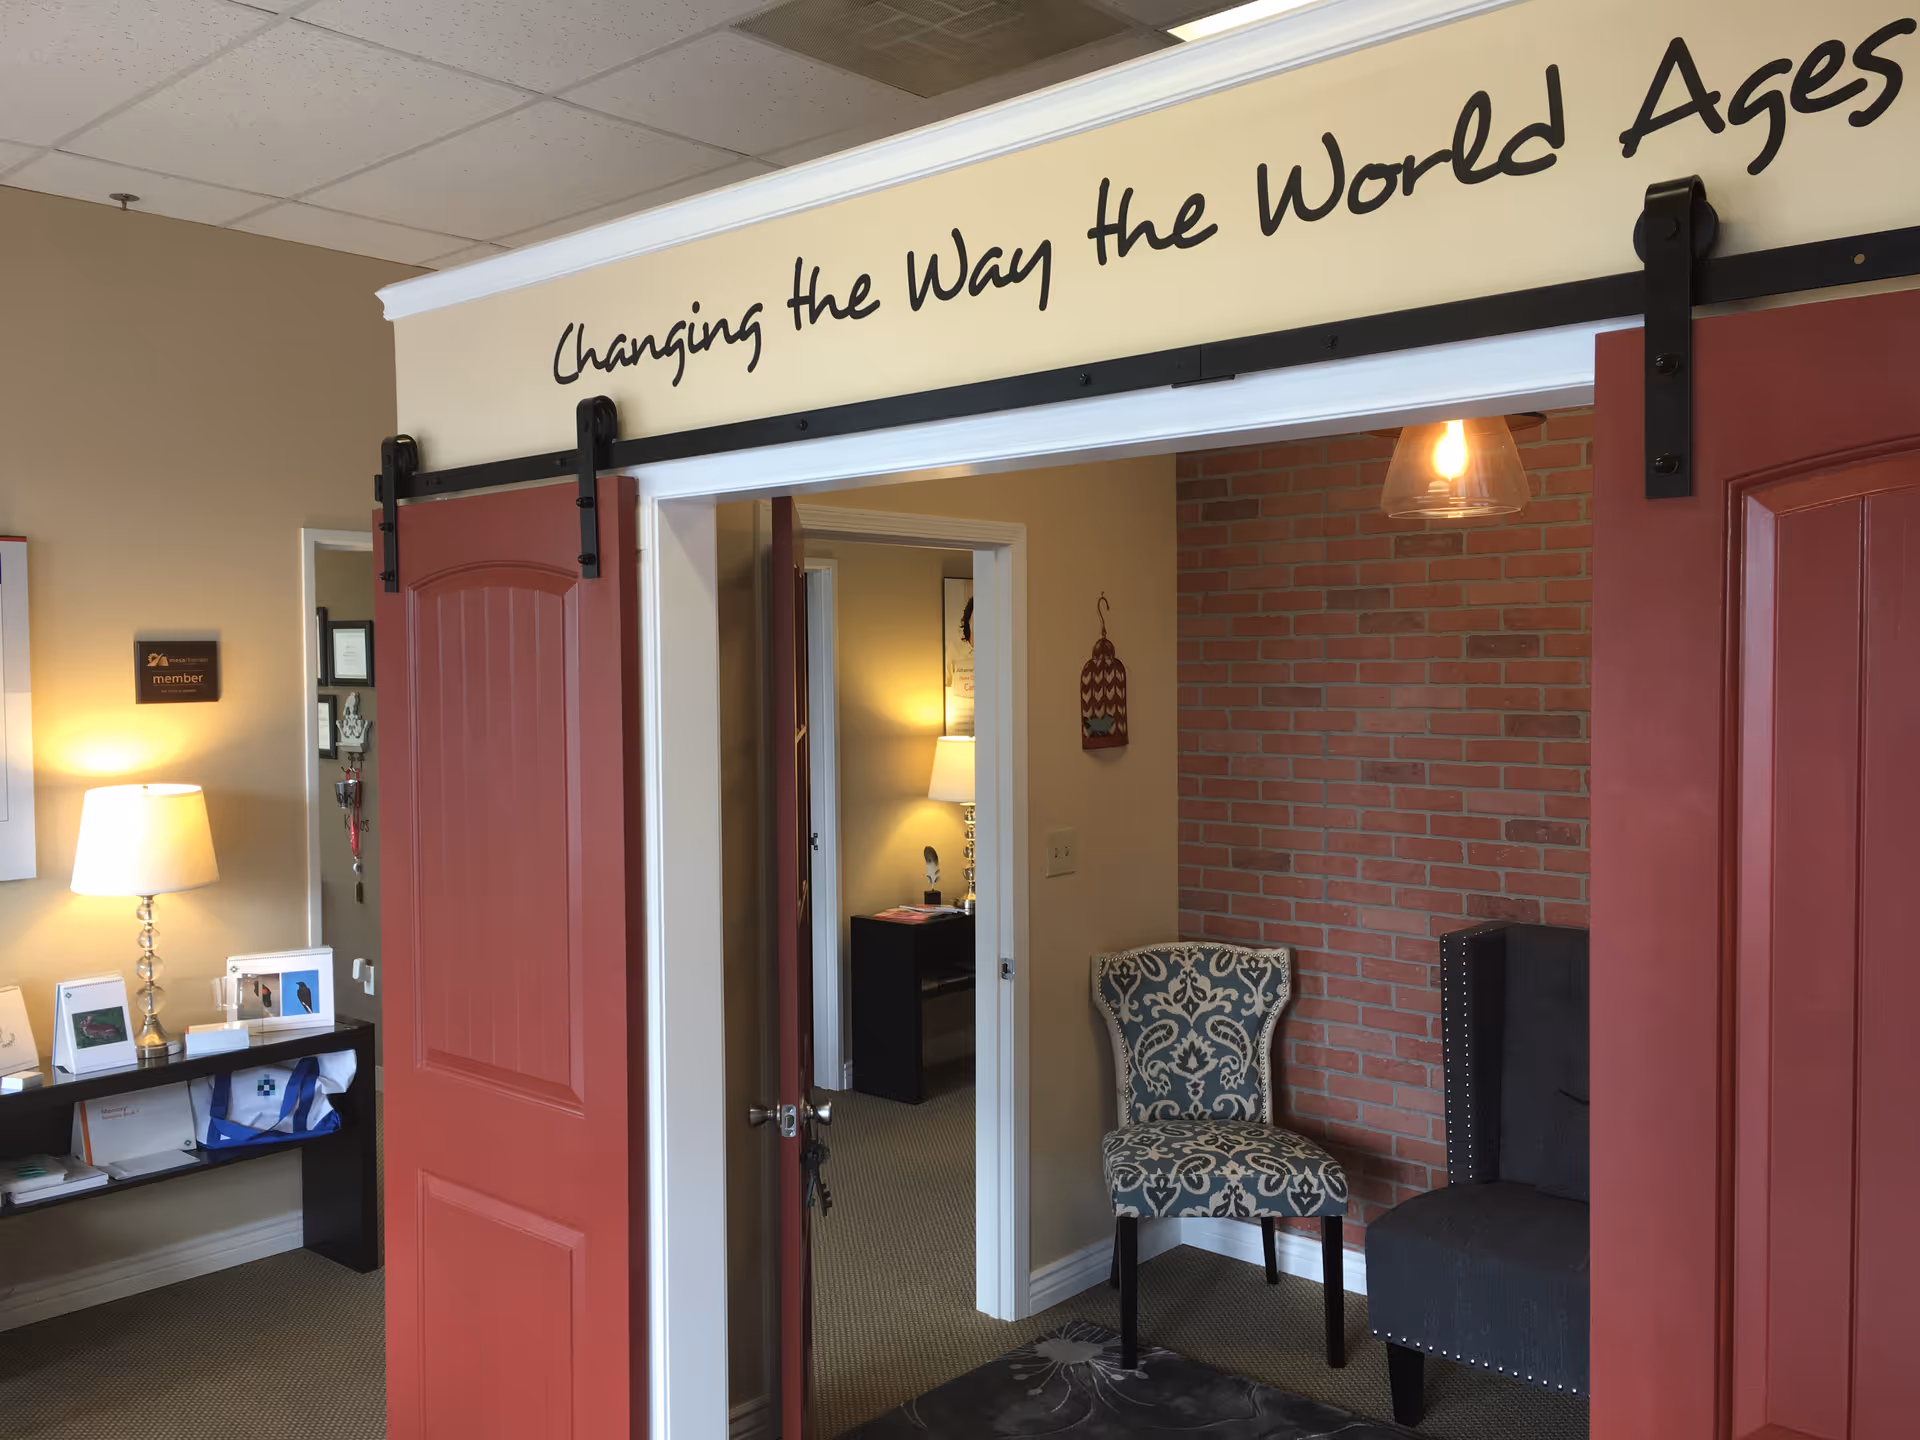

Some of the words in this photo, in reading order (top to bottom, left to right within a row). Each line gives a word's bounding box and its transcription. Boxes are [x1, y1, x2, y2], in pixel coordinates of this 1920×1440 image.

[554, 301, 763, 384] Changing
[786, 257, 881, 330] the
[906, 228, 1052, 311] Way
[1087, 178, 1218, 265] the
[1256, 64, 1566, 236] World
[1619, 17, 1918, 176] Ages
[152, 673, 203, 684] member
